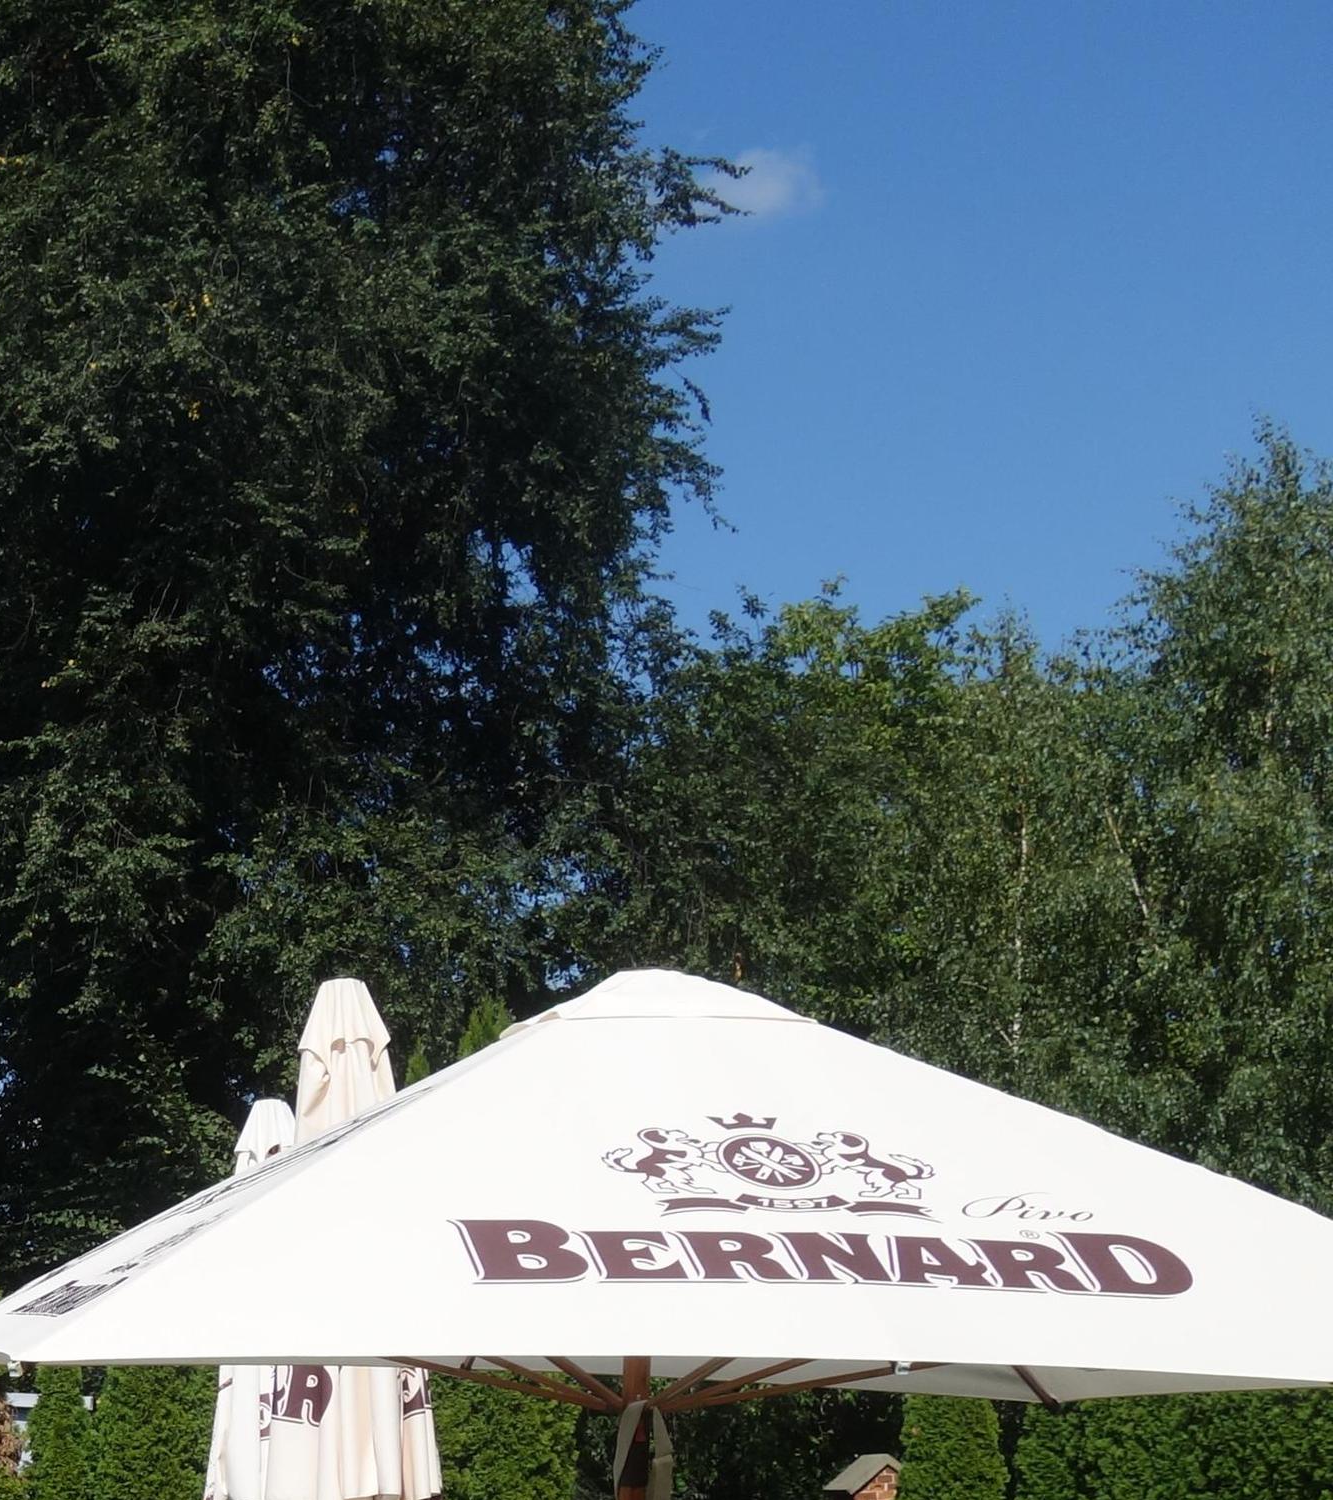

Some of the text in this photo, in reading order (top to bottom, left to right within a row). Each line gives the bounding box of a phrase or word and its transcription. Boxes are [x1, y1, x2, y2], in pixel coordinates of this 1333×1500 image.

[757, 1198, 829, 1208] 1597
[961, 1192, 1094, 1222] Pivo
[446, 1219, 1194, 1299] BERNARD
